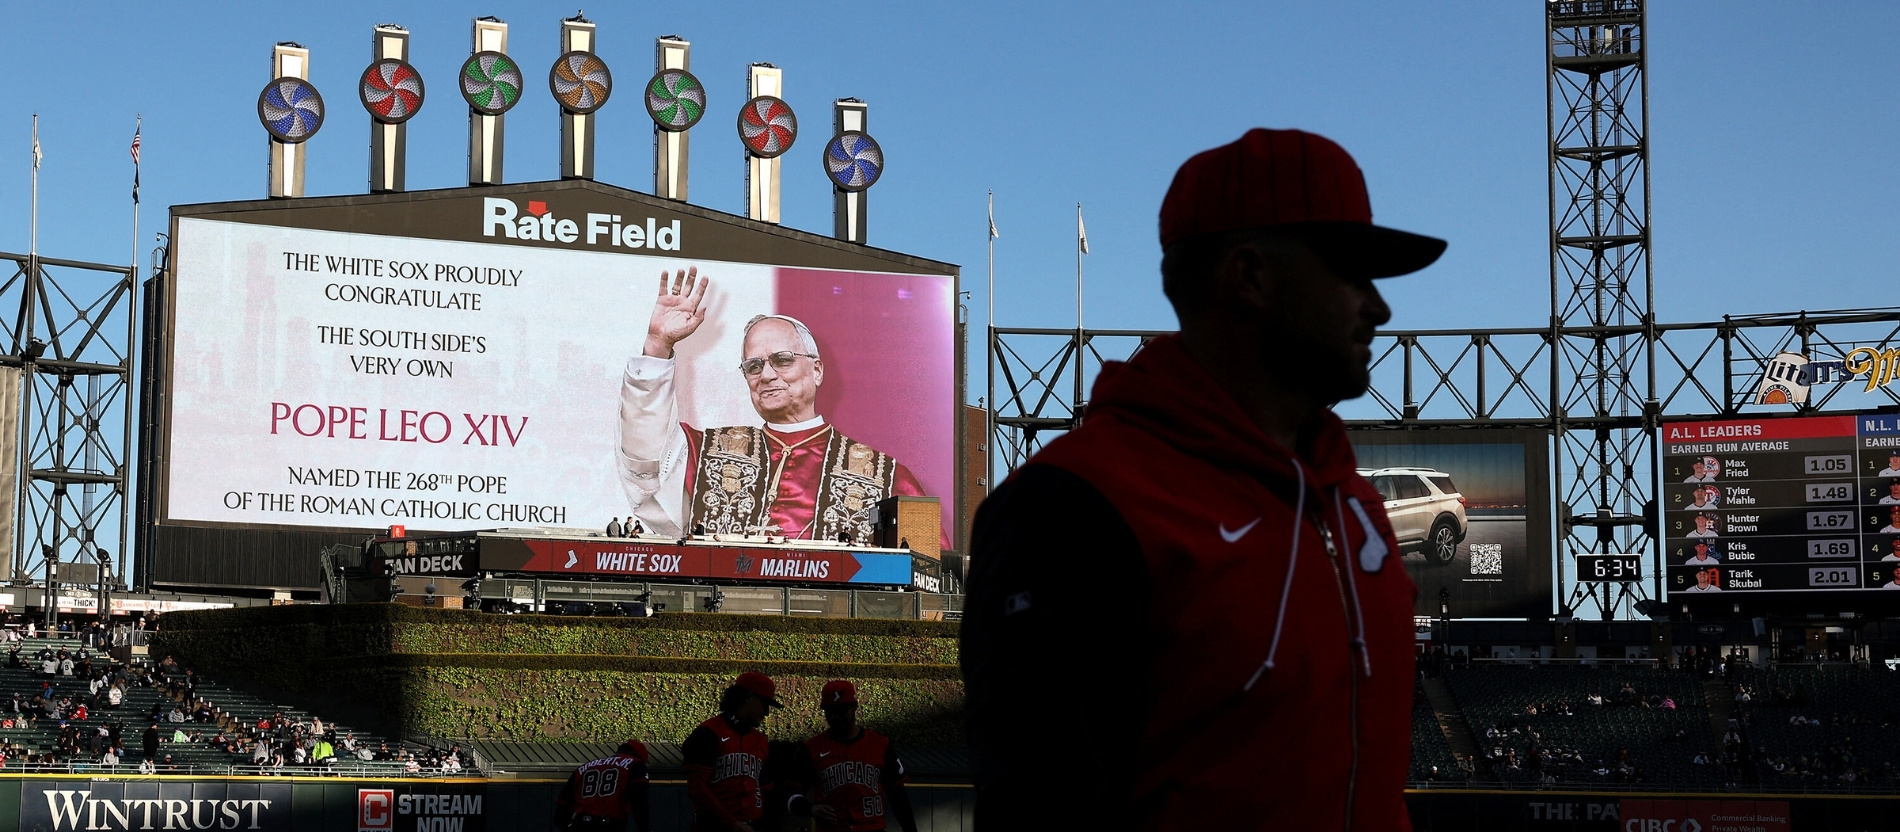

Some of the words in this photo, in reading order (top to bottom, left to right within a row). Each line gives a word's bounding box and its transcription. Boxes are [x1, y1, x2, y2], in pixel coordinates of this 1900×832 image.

[484, 197, 578, 243] Rate
[587, 213, 681, 250] Field
[283, 252, 319, 271] THE
[325, 256, 383, 277] WHITE
[389, 261, 429, 280] SOX
[435, 264, 522, 287] PROUDLY
[325, 284, 481, 311] CONGRATULATE
[318, 326, 353, 345] THE
[360, 329, 427, 349] SOUTH
[432, 334, 486, 353] SIDE'S
[351, 356, 401, 375] VERY
[407, 360, 453, 378] OWN
[1767, 361, 1810, 386] Lite
[271, 402, 368, 439] POPE
[379, 409, 451, 444] LEO
[463, 414, 528, 447] XIV
[1866, 420, 1891, 432] N.L.
[1671, 427, 1695, 439] A.L.
[1700, 425, 1762, 438] LEADERS
[1671, 445, 1713, 454] EARNED
[1717, 443, 1738, 452] RUN
[1742, 442, 1789, 451] AVERAGE
[1725, 459, 1746, 468] Max
[1811, 459, 1846, 471] 1.05
[1869, 461, 1875, 469] 1
[1675, 467, 1680, 475] 1
[1725, 468, 1749, 477] Fried
[288, 467, 360, 488] NAMED
[365, 471, 401, 489] THE
[407, 473, 453, 491] 268TH
[458, 475, 507, 494] POPE
[1726, 487, 1750, 496] Tyler
[1812, 487, 1847, 499] 1.48
[1870, 488, 1876, 497] 2
[1675, 494, 1681, 502] 2
[1726, 496, 1755, 505] Mahle
[224, 492, 253, 510] OF
[258, 493, 295, 511] THE
[301, 495, 375, 515] ROMAN
[381, 499, 481, 520] CATHOLIC
[487, 504, 567, 524] CHURCH
[1727, 514, 1759, 523] Hunter
[1813, 515, 1848, 527] 1.67
[1870, 516, 1877, 525] 3
[1676, 522, 1682, 530] 3
[1727, 524, 1758, 533] Brown
[1676, 548, 1683, 556] 4
[1728, 542, 1746, 551] Kris
[1814, 543, 1849, 555] 1.69
[1871, 544, 1879, 552] 4
[1728, 551, 1755, 560] Bubic
[420, 555, 463, 573] DECK
[597, 552, 647, 572] WHITE
[649, 554, 682, 573] SOX
[760, 558, 830, 579] MARLINS
[1595, 559, 1637, 577] 6:34
[1677, 576, 1684, 584] 5
[1729, 570, 1753, 578] Tarik
[1814, 571, 1850, 583] 2.01
[1873, 572, 1880, 580] 5
[914, 571, 925, 589] FAN
[926, 575, 940, 594] DECK
[1729, 579, 1762, 588] Skubal
[582, 768, 619, 798] 88
[817, 761, 881, 797] CHICAGO
[43, 790, 269, 831] WINTRUST
[398, 794, 482, 815] STREAM
[863, 795, 883, 817] 50
[1529, 802, 1579, 820] THE
[1587, 803, 1620, 821] PA
[417, 817, 464, 832] NOW
[1626, 818, 1677, 832] CIBC
[1711, 814, 1755, 822] Commercial
[1756, 814, 1786, 824] Banking
